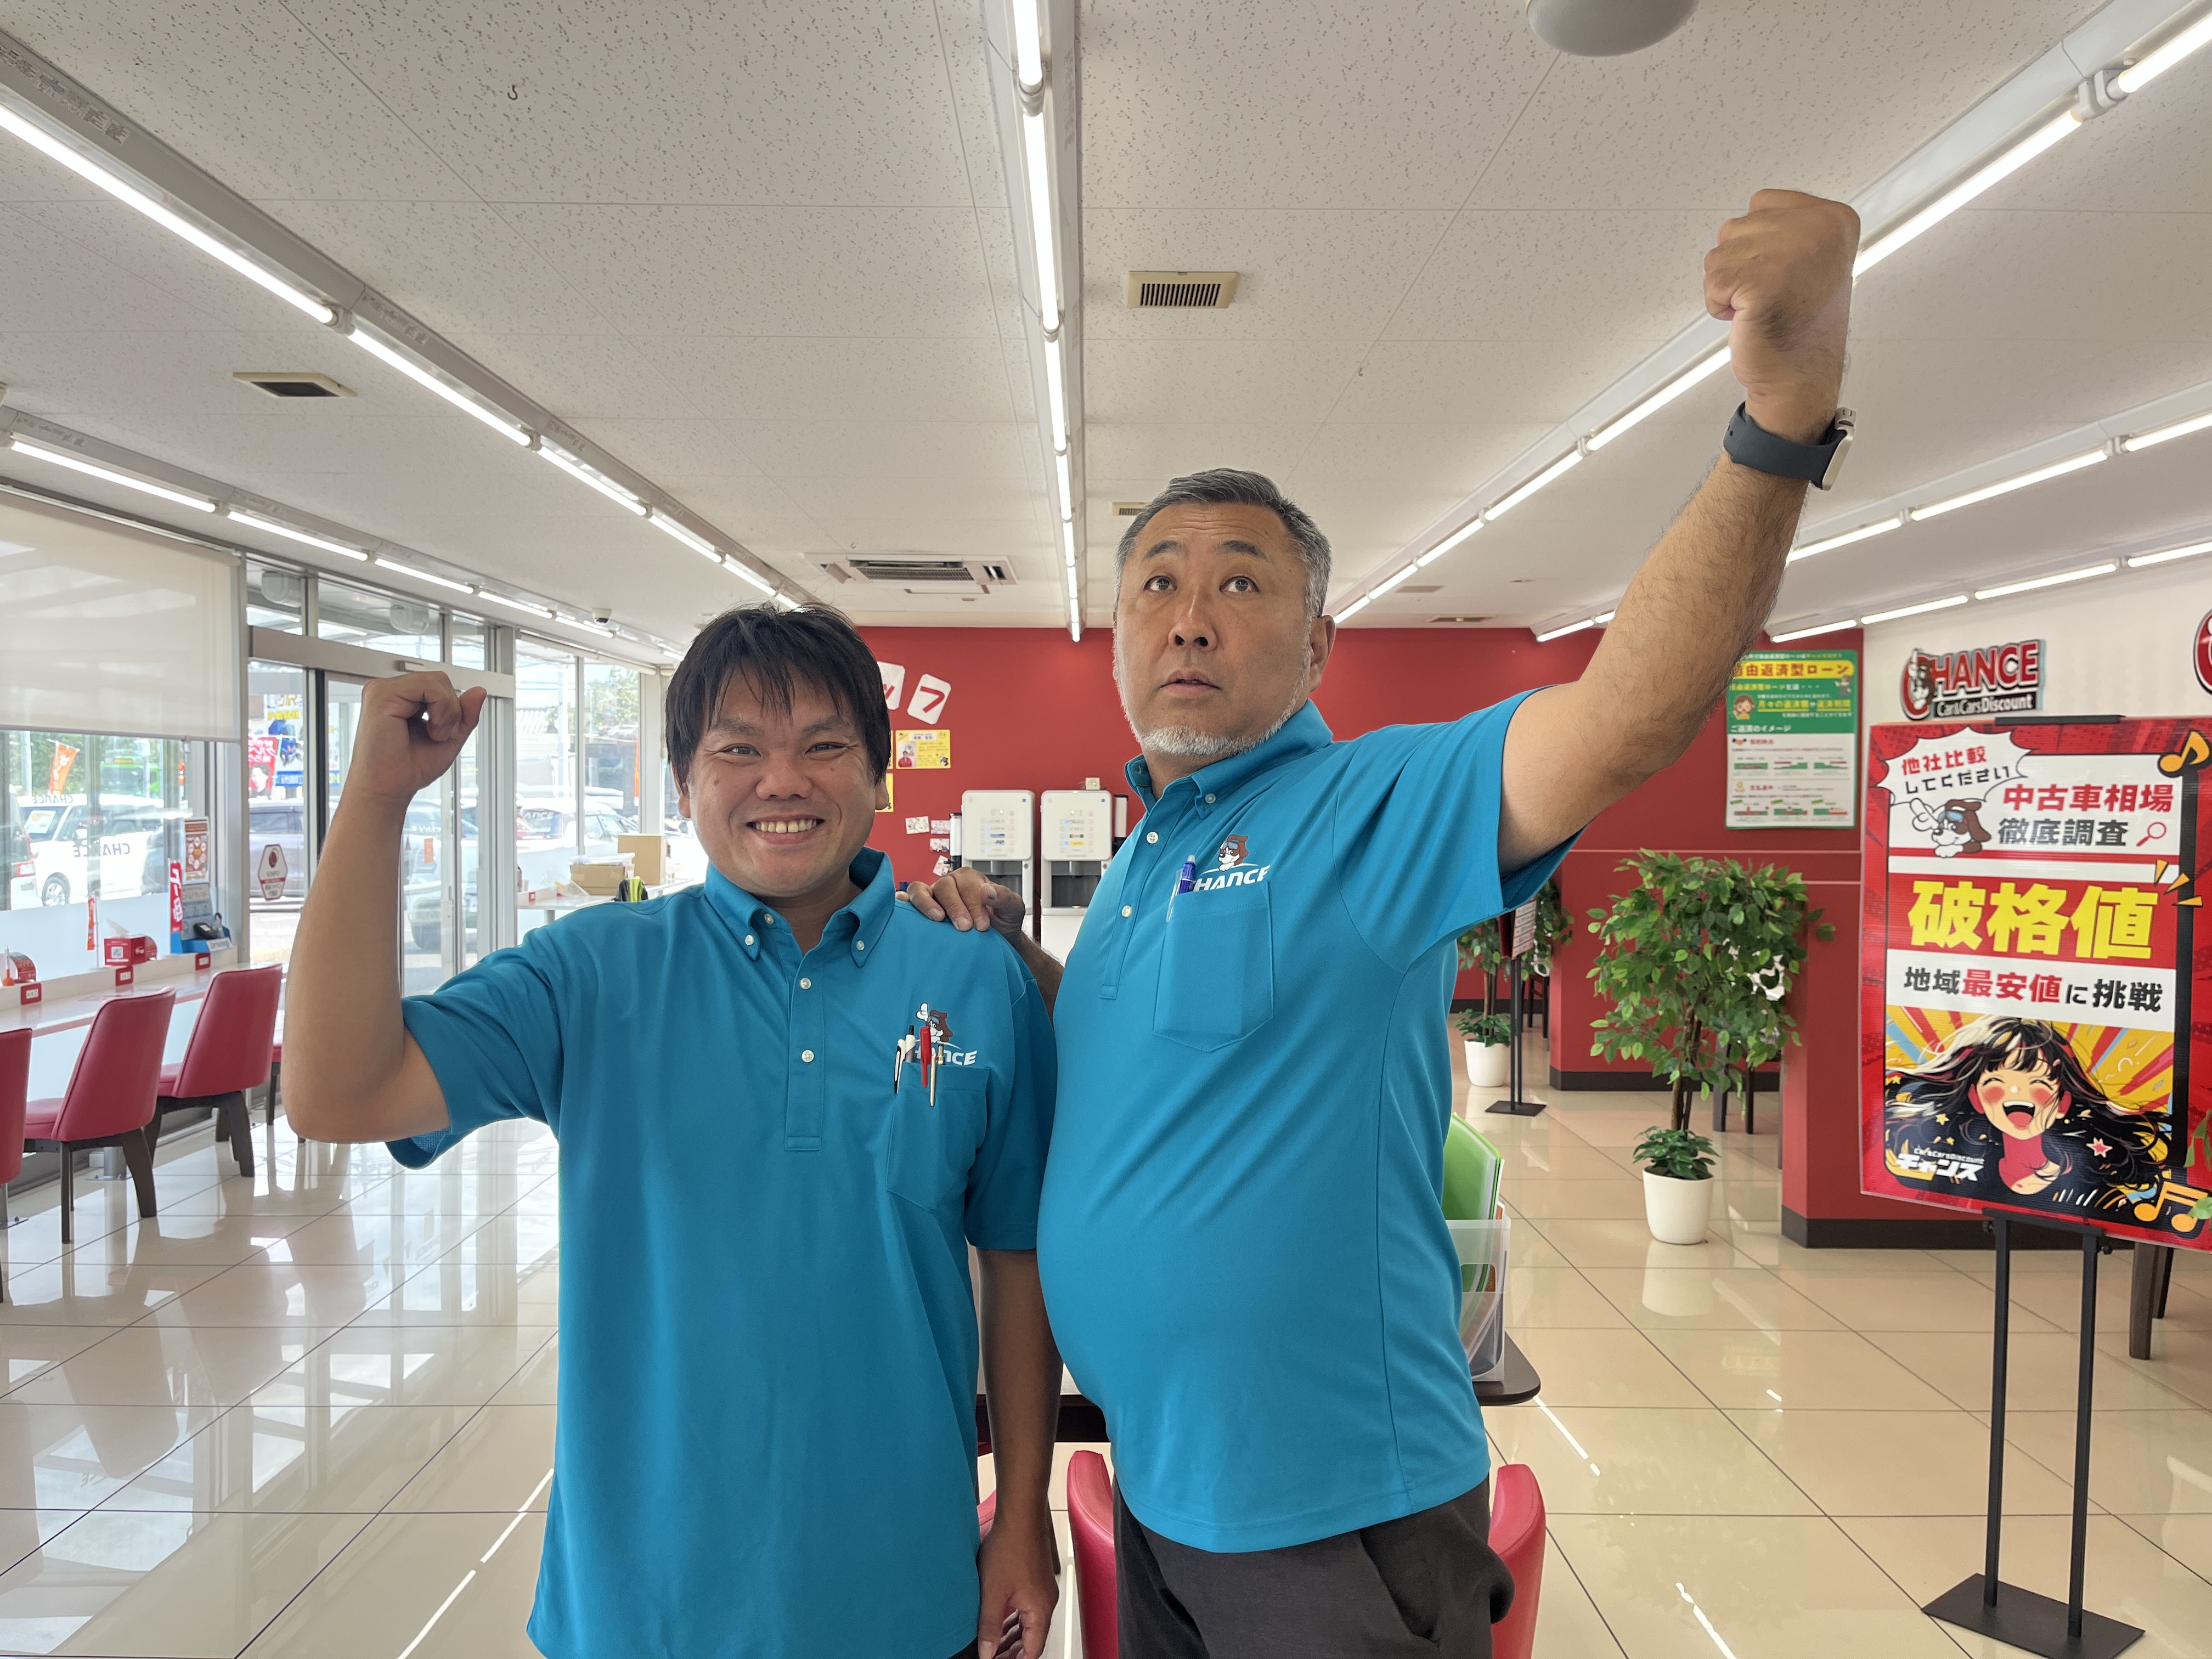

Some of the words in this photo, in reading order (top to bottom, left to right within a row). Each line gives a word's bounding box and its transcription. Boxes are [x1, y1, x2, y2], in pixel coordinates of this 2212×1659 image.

[1902, 746, 1987, 775] 他社比較
[1905, 766, 2010, 794] してください
[2003, 783, 2174, 812] 中古車相場
[1998, 818, 2129, 846] 徹底調査
[1192, 864, 1271, 892] HANCE
[1908, 880, 2159, 959] 破格値
[1903, 966, 2164, 1013] 地域最安値に挑戦
[1895, 1153, 1985, 1181] チャンス
